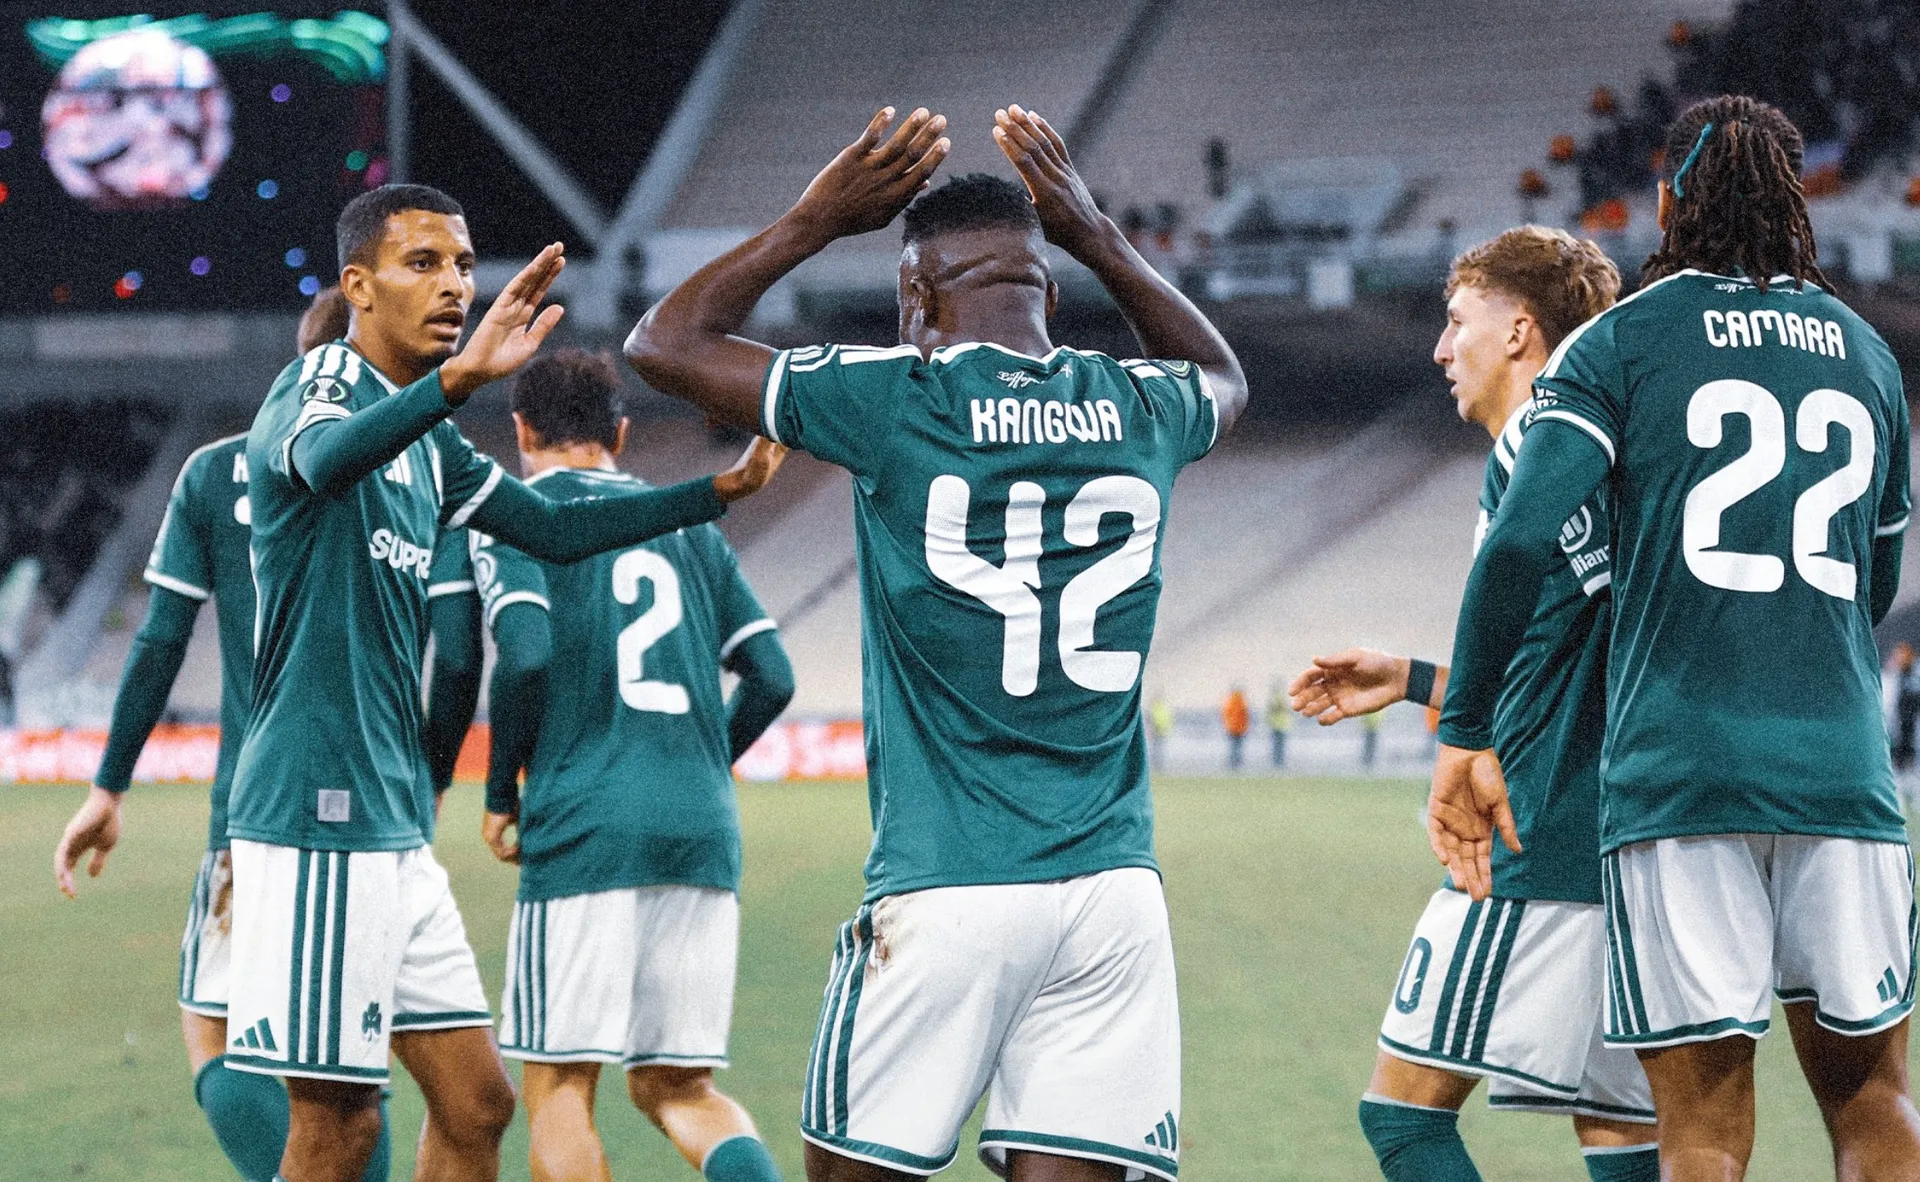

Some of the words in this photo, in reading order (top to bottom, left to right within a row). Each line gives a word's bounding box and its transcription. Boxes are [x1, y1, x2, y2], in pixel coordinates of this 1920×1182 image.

[1703, 309, 1846, 360] CAMARA
[970, 397, 1122, 444] KANGWA
[1683, 379, 1876, 602] 22
[612, 549, 690, 715] 2
[925, 474, 1161, 697] 42
